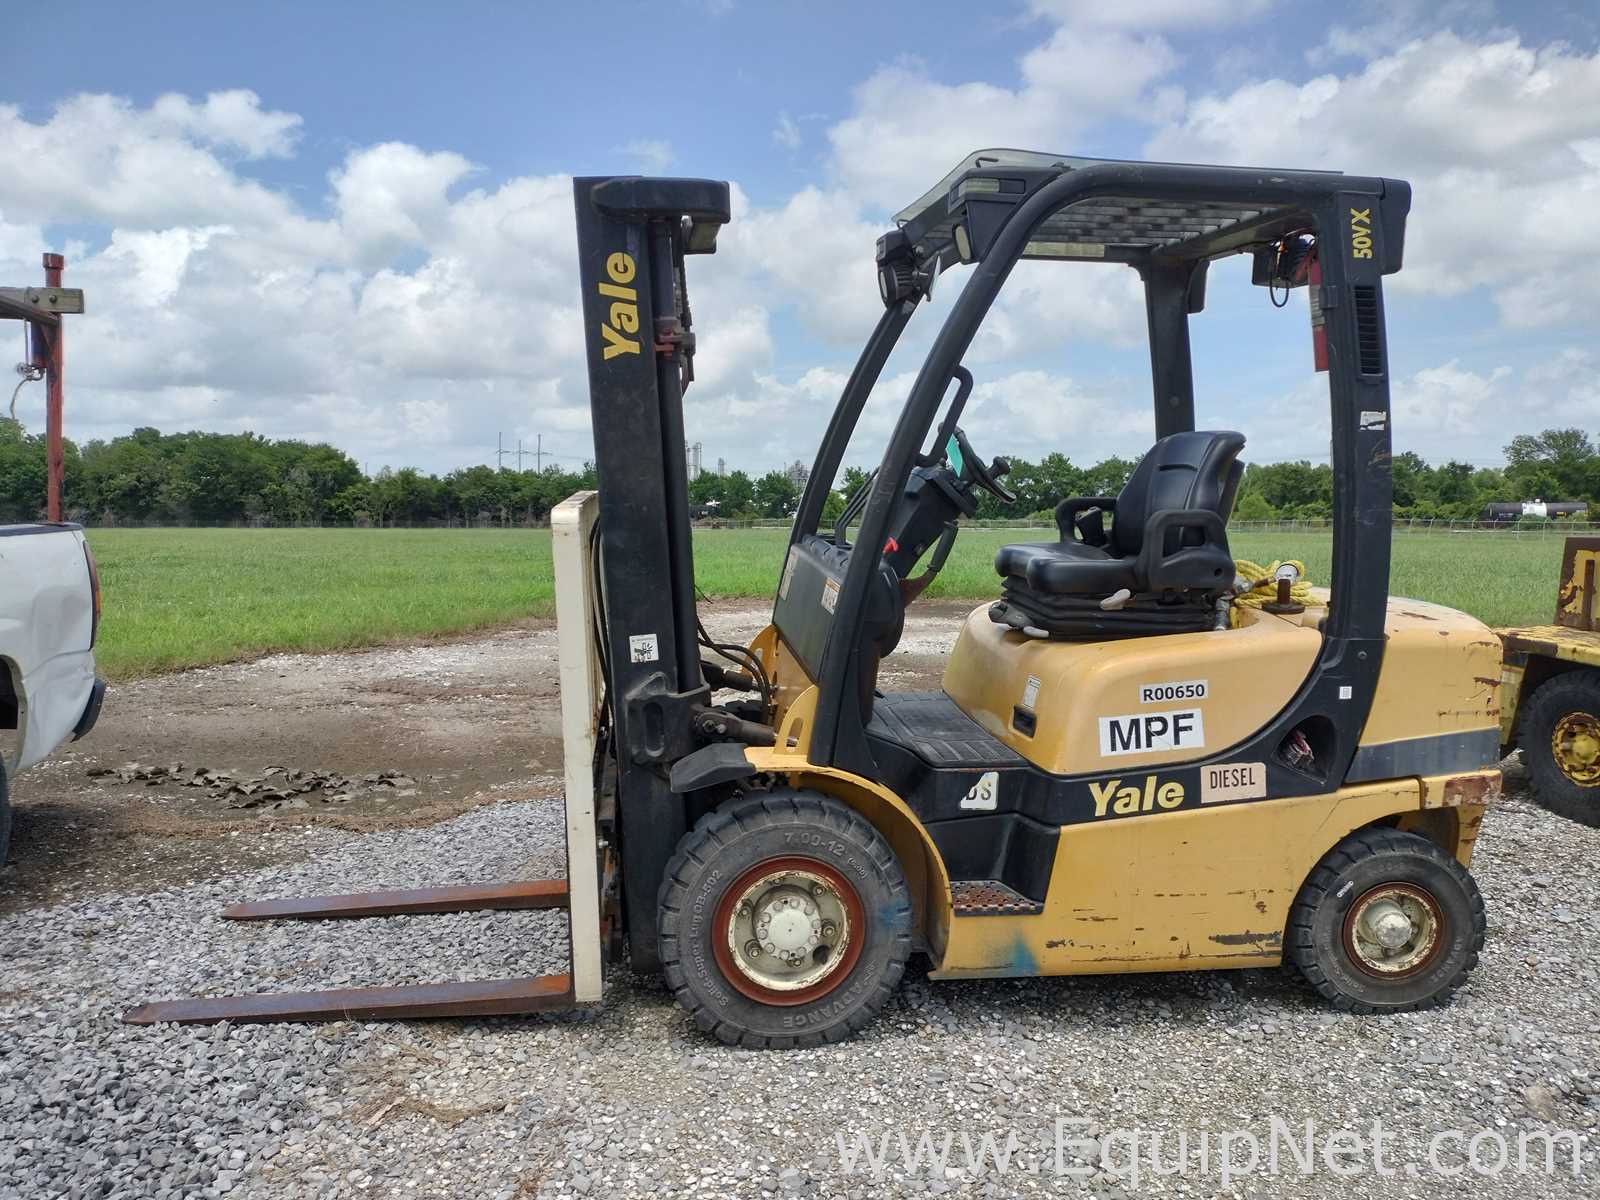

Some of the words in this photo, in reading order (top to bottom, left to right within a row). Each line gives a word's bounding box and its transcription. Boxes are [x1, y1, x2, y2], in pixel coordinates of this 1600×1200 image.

[1350, 207, 1373, 259] 50VX
[598, 252, 641, 361] Yale
[1143, 683, 1205, 702] R00650
[1109, 712, 1194, 752] MPF
[1088, 775, 1185, 817] Yale
[1210, 767, 1256, 789] DIESEL
[783, 981, 862, 1029] ADVANCE
